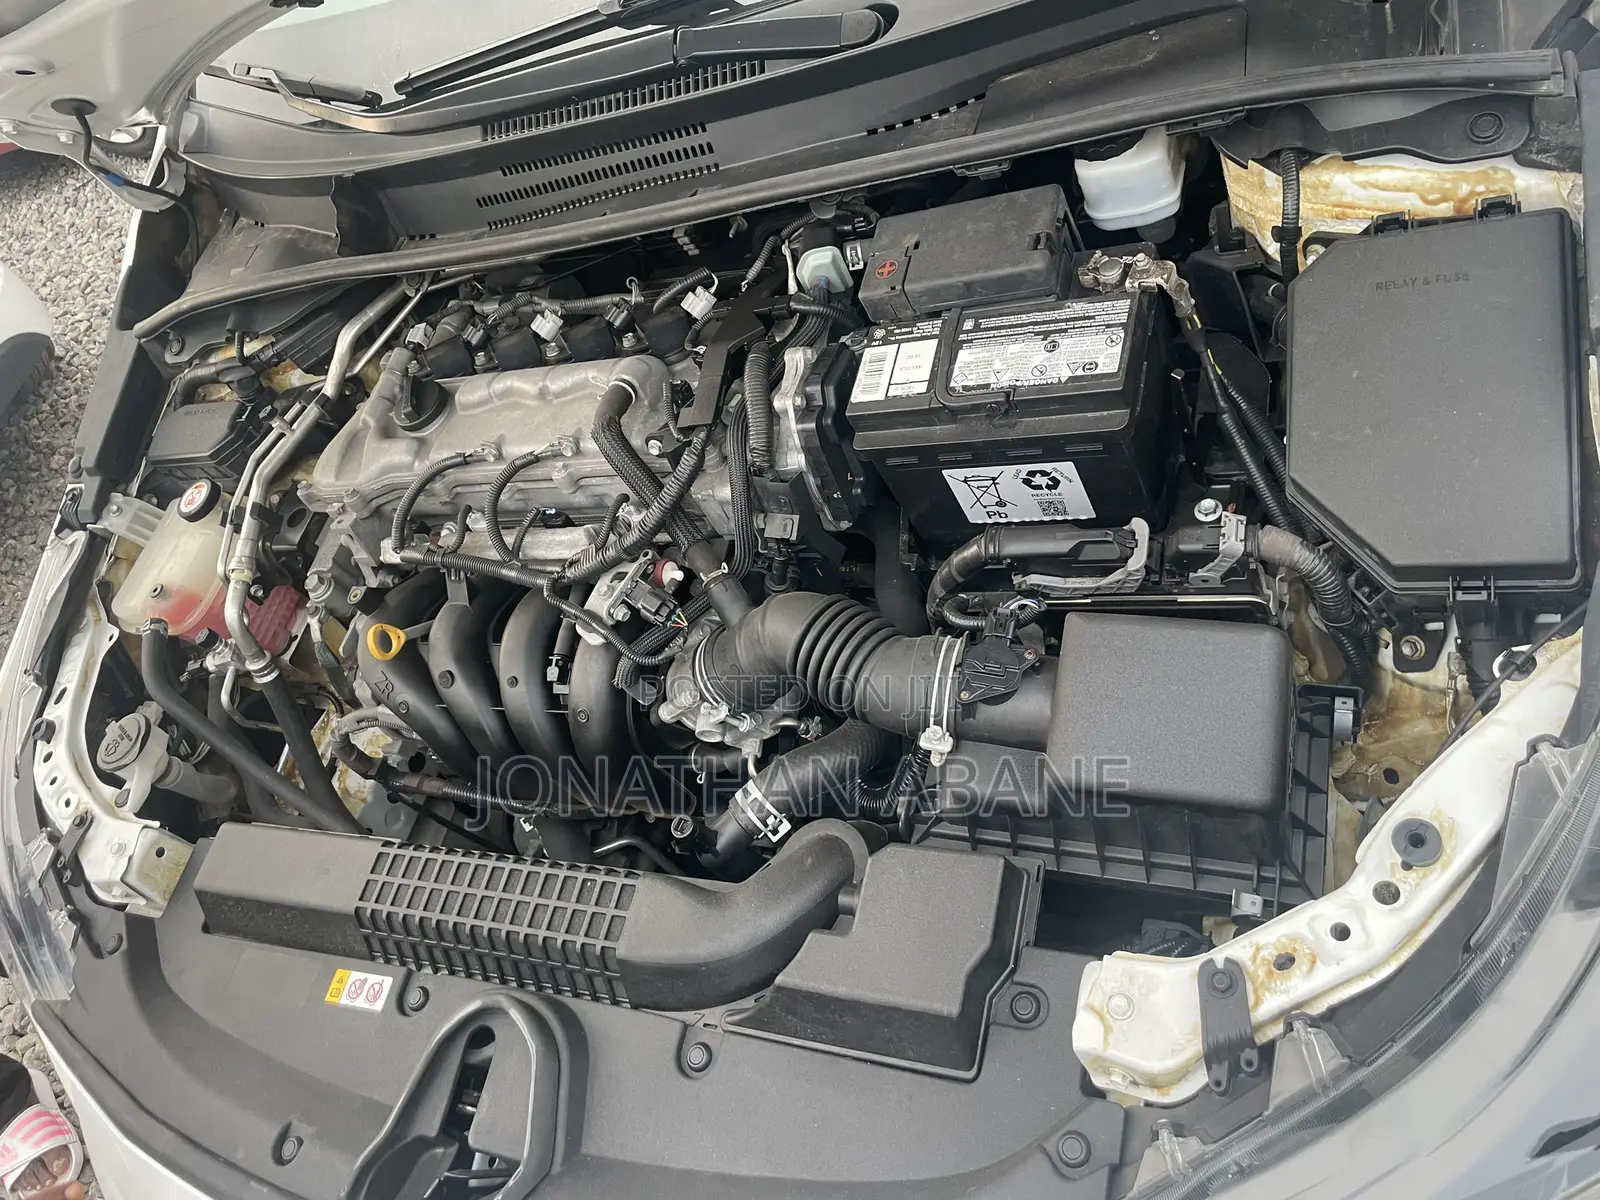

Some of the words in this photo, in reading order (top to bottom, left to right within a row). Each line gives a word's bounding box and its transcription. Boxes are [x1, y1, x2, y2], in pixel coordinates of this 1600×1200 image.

[1375, 278, 1417, 291] RELAY
[1422, 277, 1431, 286] &
[1435, 271, 1470, 284] FUSE
[1012, 468, 1022, 480] LEAD
[1051, 467, 1073, 483] RETURN
[985, 510, 1009, 519] Pb
